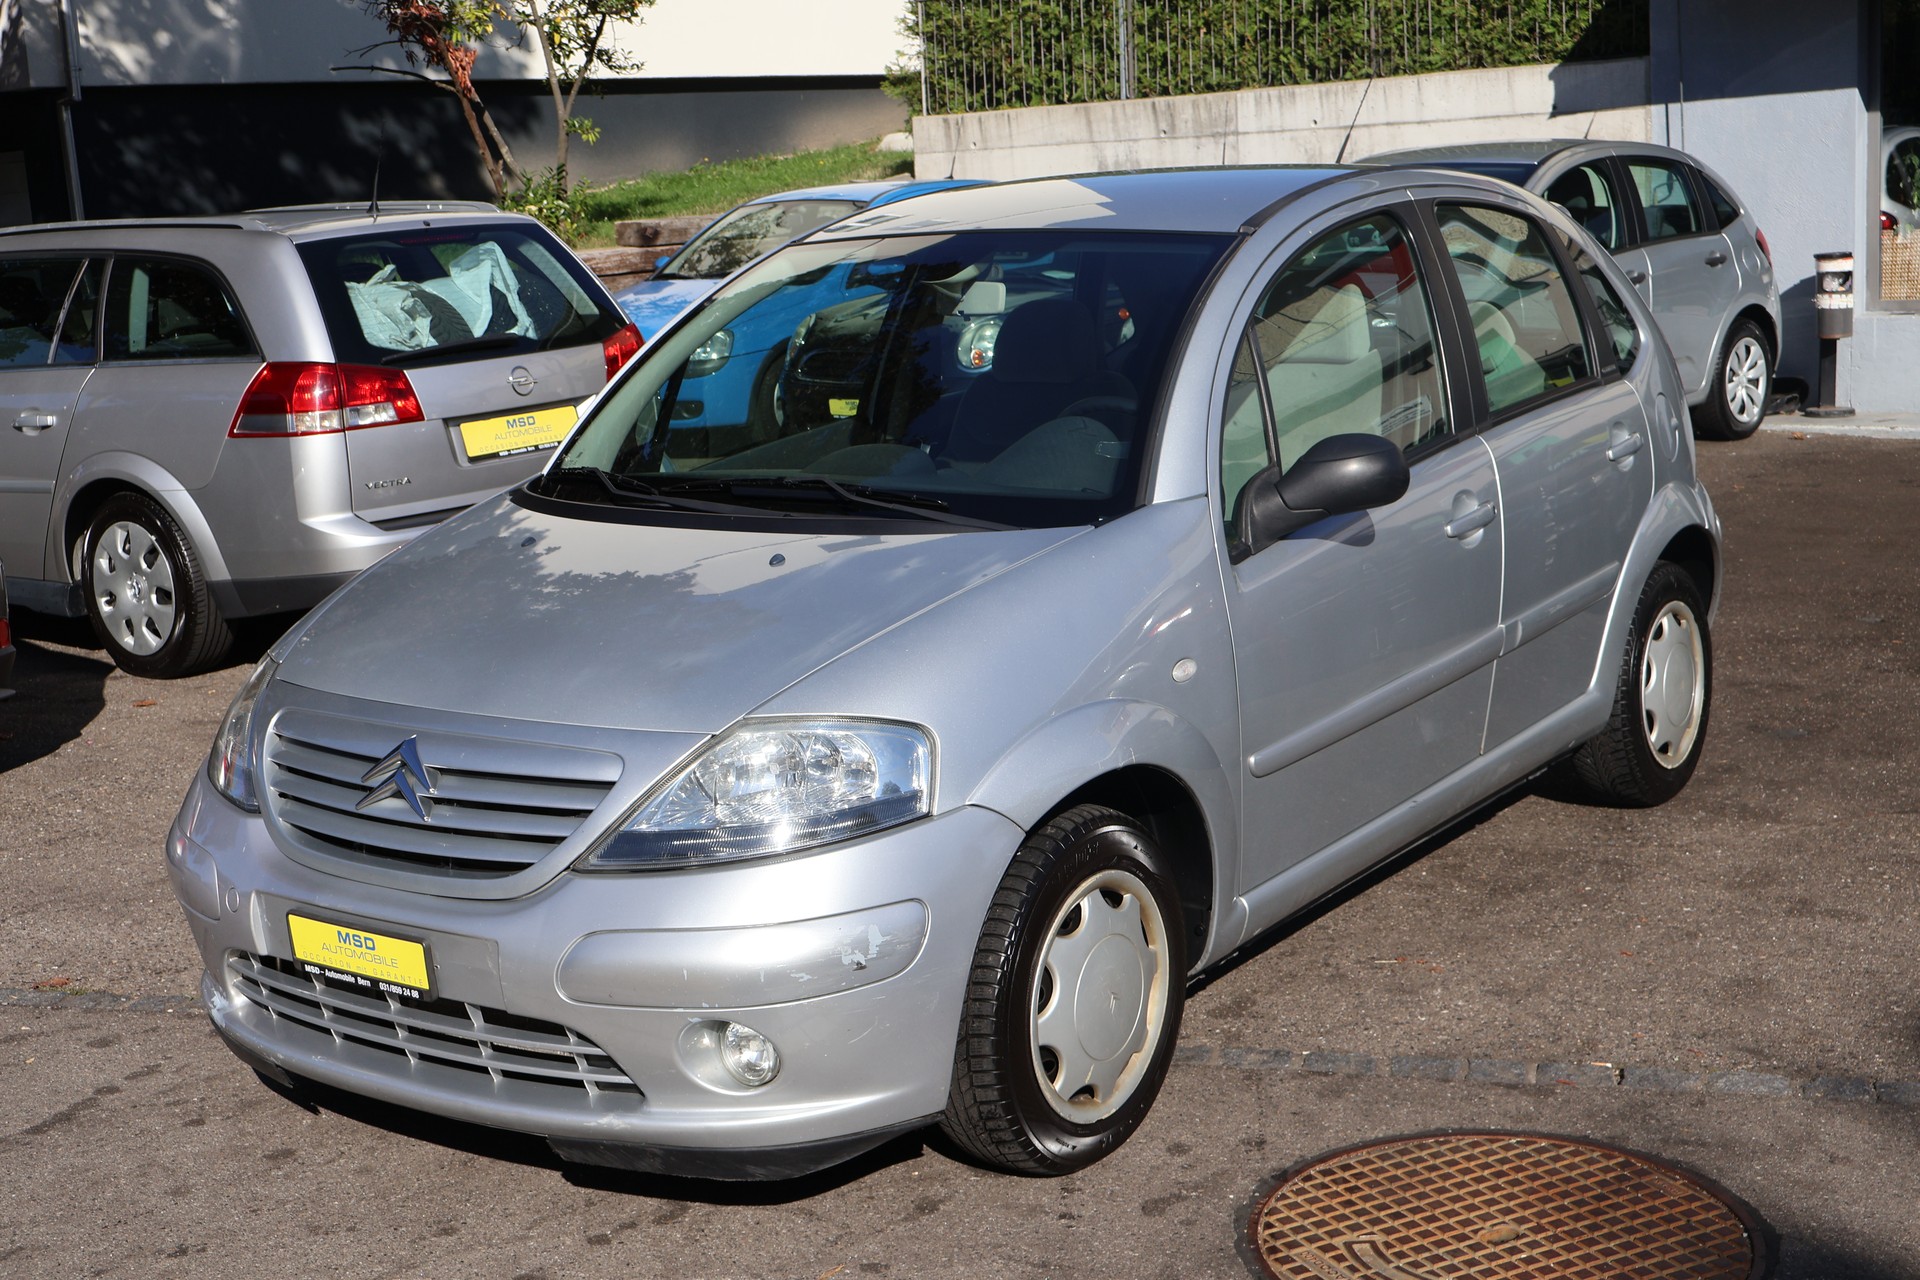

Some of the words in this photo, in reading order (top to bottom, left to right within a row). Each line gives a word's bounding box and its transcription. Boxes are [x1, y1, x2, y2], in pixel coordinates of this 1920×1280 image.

[506, 416, 536, 430] MSD
[494, 425, 553, 441] AUTOMOBILE
[365, 477, 412, 490] VECTRA
[337, 930, 376, 951] MSD
[322, 942, 399, 969] AUTOMOBILE
[303, 950, 352, 969] OCCASION
[373, 968, 424, 987] GARANTIE
[325, 969, 356, 983] Automobile
[357, 976, 371, 987] Bern
